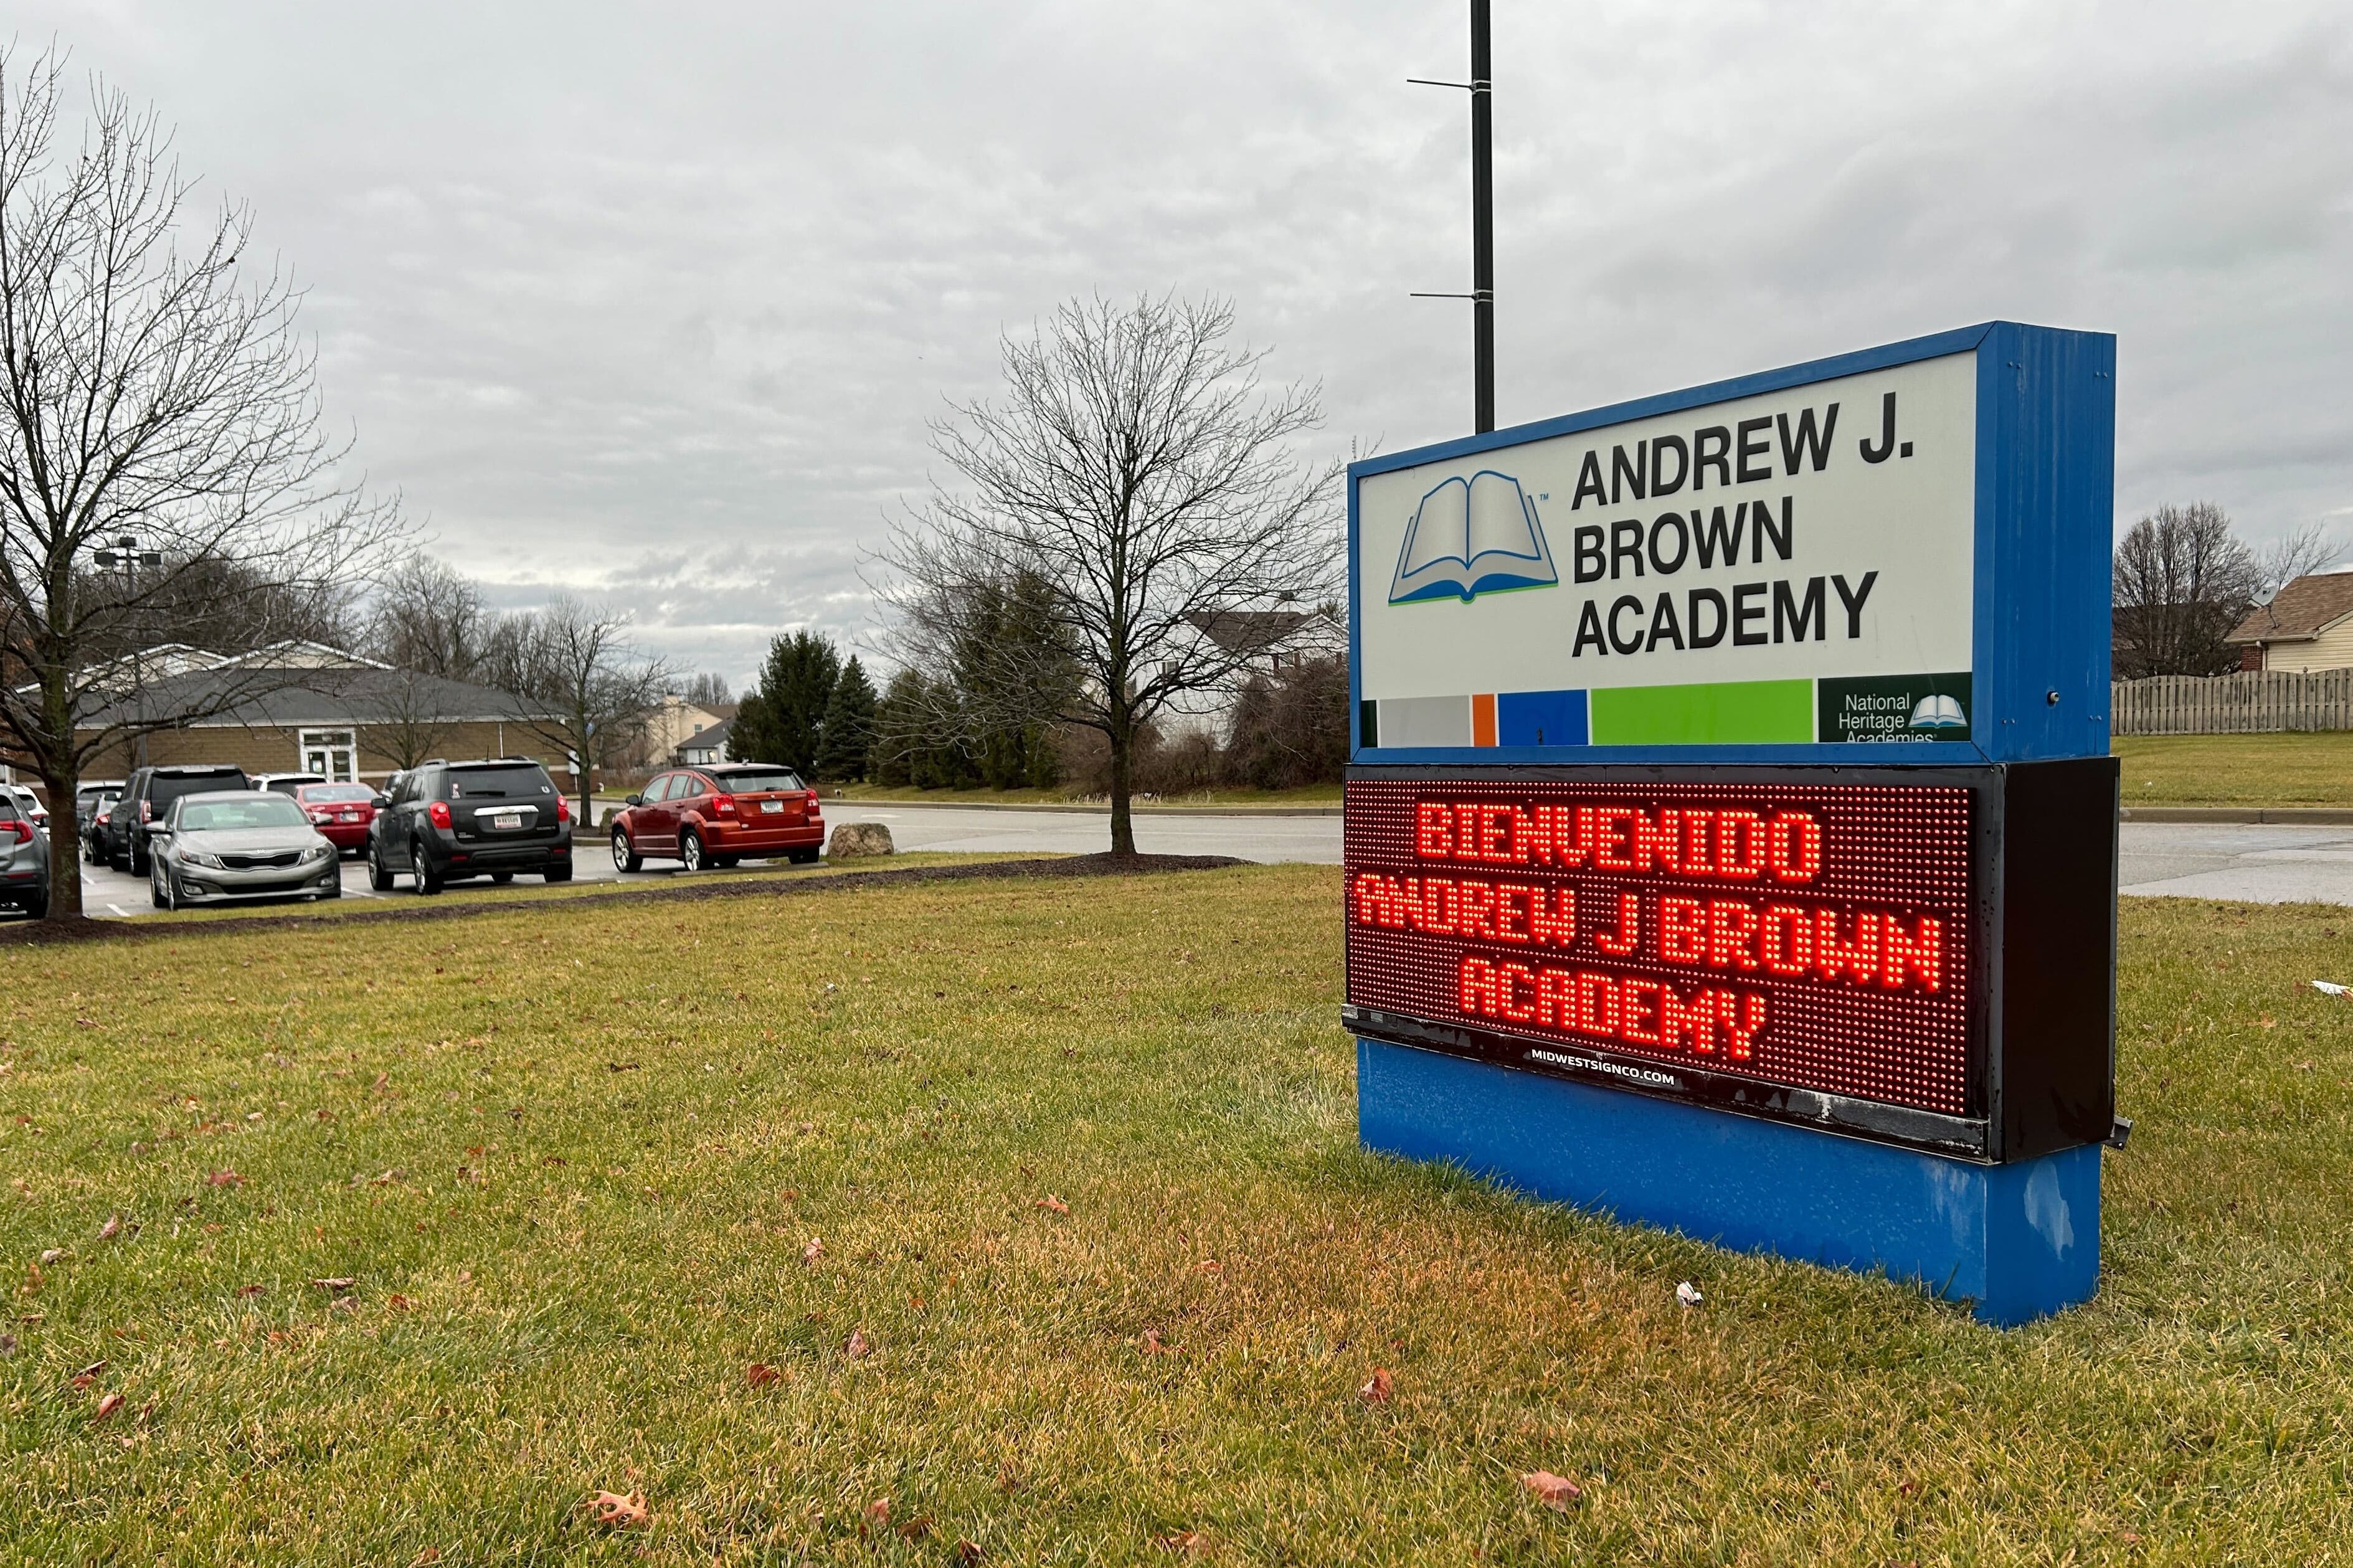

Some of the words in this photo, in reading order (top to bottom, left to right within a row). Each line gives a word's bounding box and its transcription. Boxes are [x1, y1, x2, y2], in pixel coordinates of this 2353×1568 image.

[1571, 402, 1840, 511] ANDREW
[1859, 391, 1914, 464] J.
[1540, 493, 1549, 501] TM
[1574, 496, 1792, 584] BROWN
[1571, 570, 1879, 658] ACADEMY
[1839, 712, 1905, 733] Heritage
[1845, 692, 1910, 711] National
[1418, 802, 1820, 879] BIENVENIDO
[1355, 872, 1576, 947] ANDREW
[1598, 893, 1639, 955] J
[1660, 894, 1941, 992] BROWN
[1462, 957, 1766, 1058] ACADEMY
[1532, 1049, 1675, 1085] MIDWESTSIGNCO.COM
